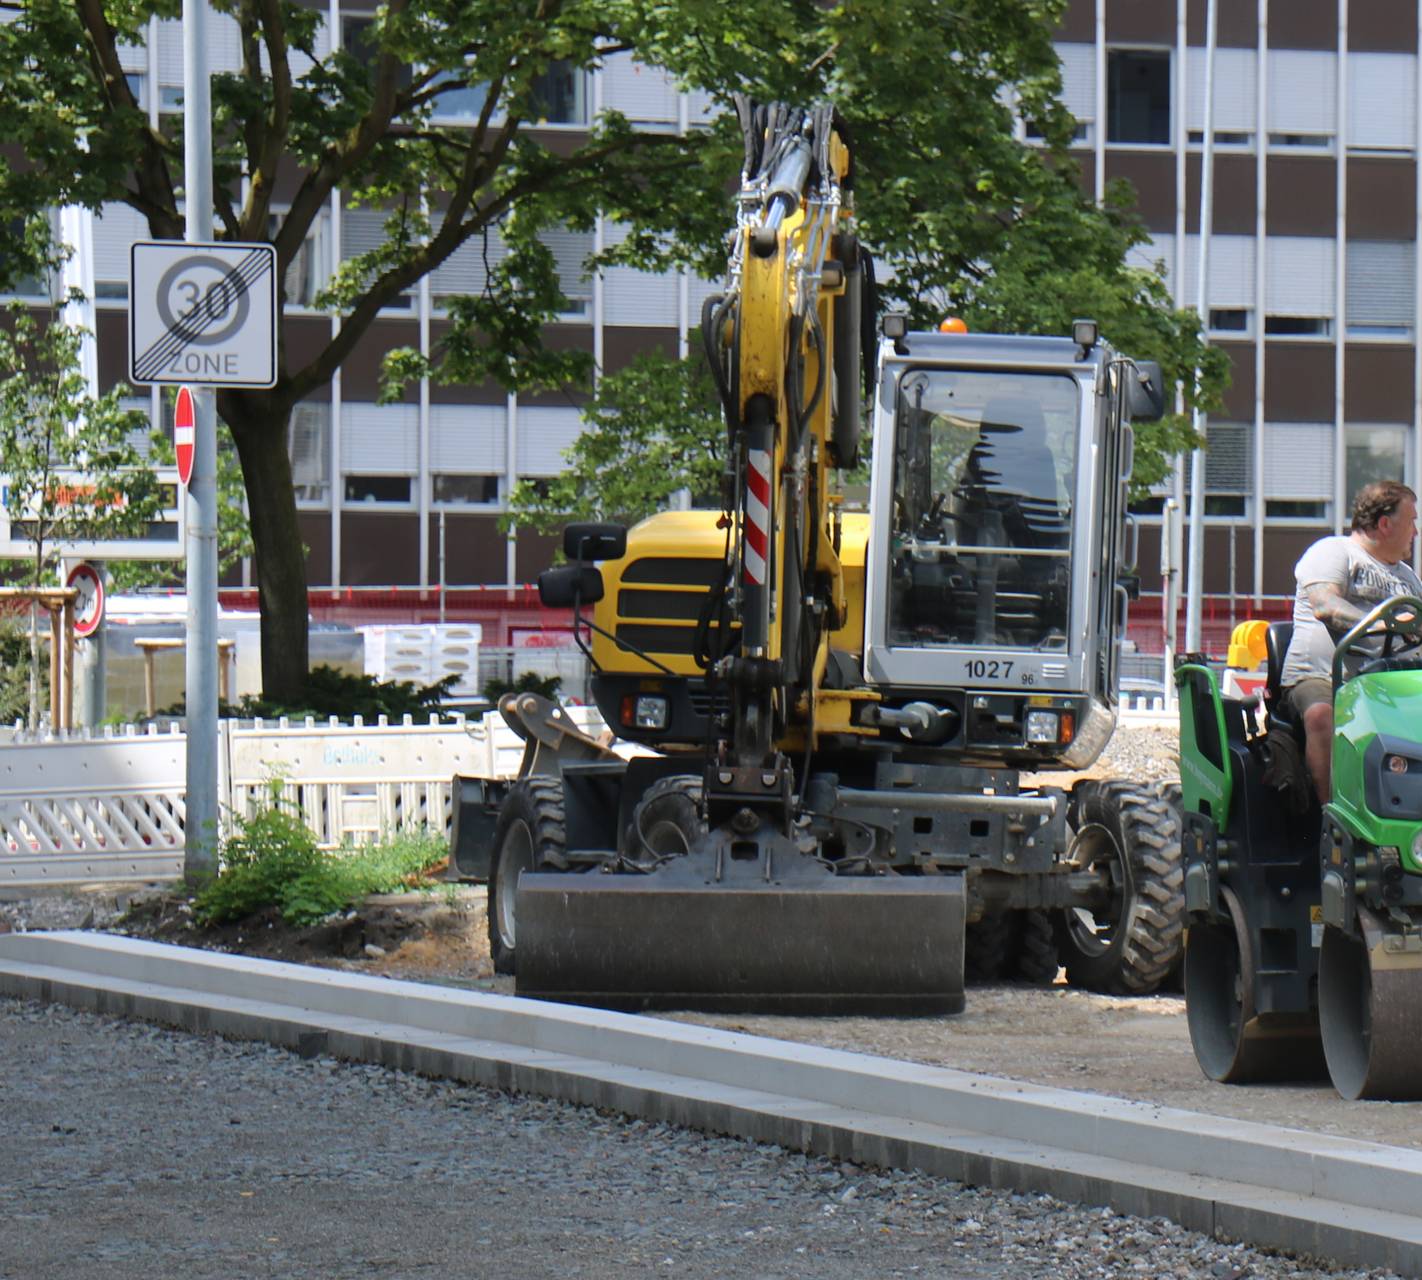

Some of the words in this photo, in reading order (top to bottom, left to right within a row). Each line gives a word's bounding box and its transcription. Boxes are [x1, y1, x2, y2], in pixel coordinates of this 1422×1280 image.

[176, 280, 230, 322] 30
[168, 353, 239, 375] ZONE
[964, 660, 1015, 679] 1027
